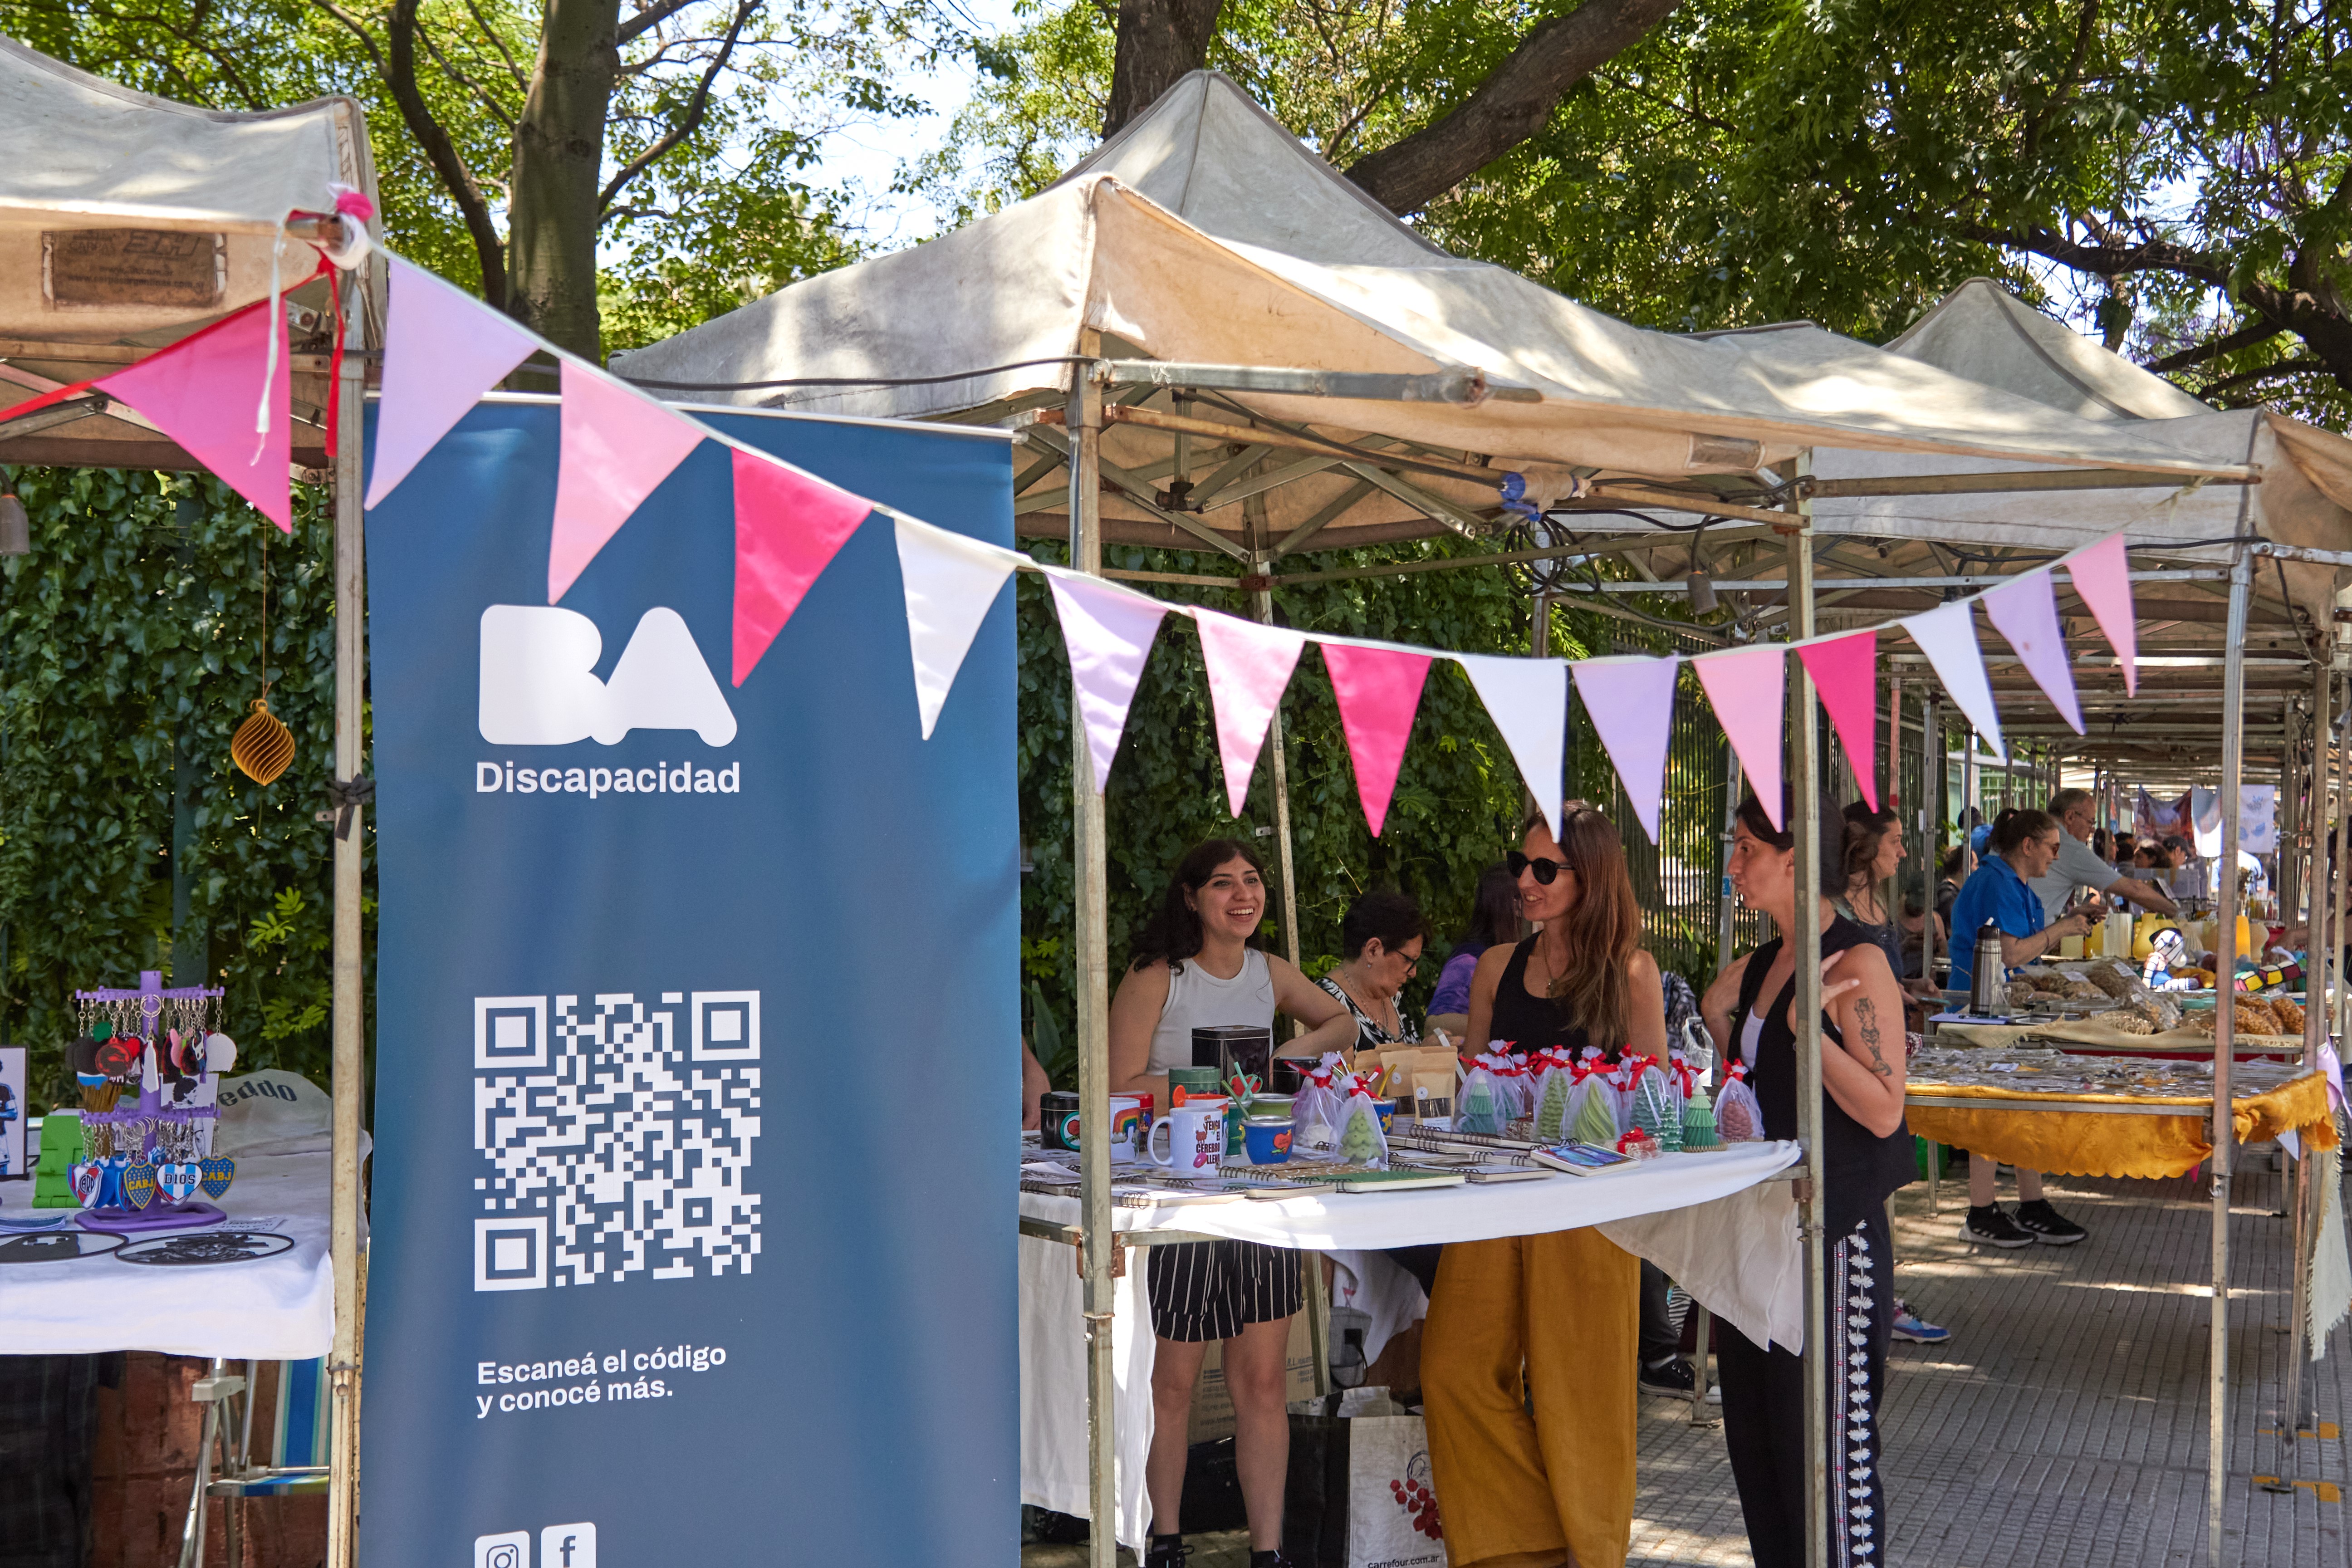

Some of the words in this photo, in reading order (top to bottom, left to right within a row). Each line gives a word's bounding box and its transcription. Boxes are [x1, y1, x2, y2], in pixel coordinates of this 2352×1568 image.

[479, 604, 737, 747] BA
[476, 761, 740, 799] Discapacidad
[218, 1080, 297, 1106] eddo
[128, 1179, 153, 1190] CABJ
[477, 1352, 597, 1385] Escaneá
[603, 1350, 626, 1373] el
[633, 1344, 726, 1372] código
[476, 1395, 493, 1419] y
[500, 1380, 601, 1412] conocé
[608, 1376, 673, 1401] más.
[1367, 1555, 1440, 1568] carrefour.com.ar
